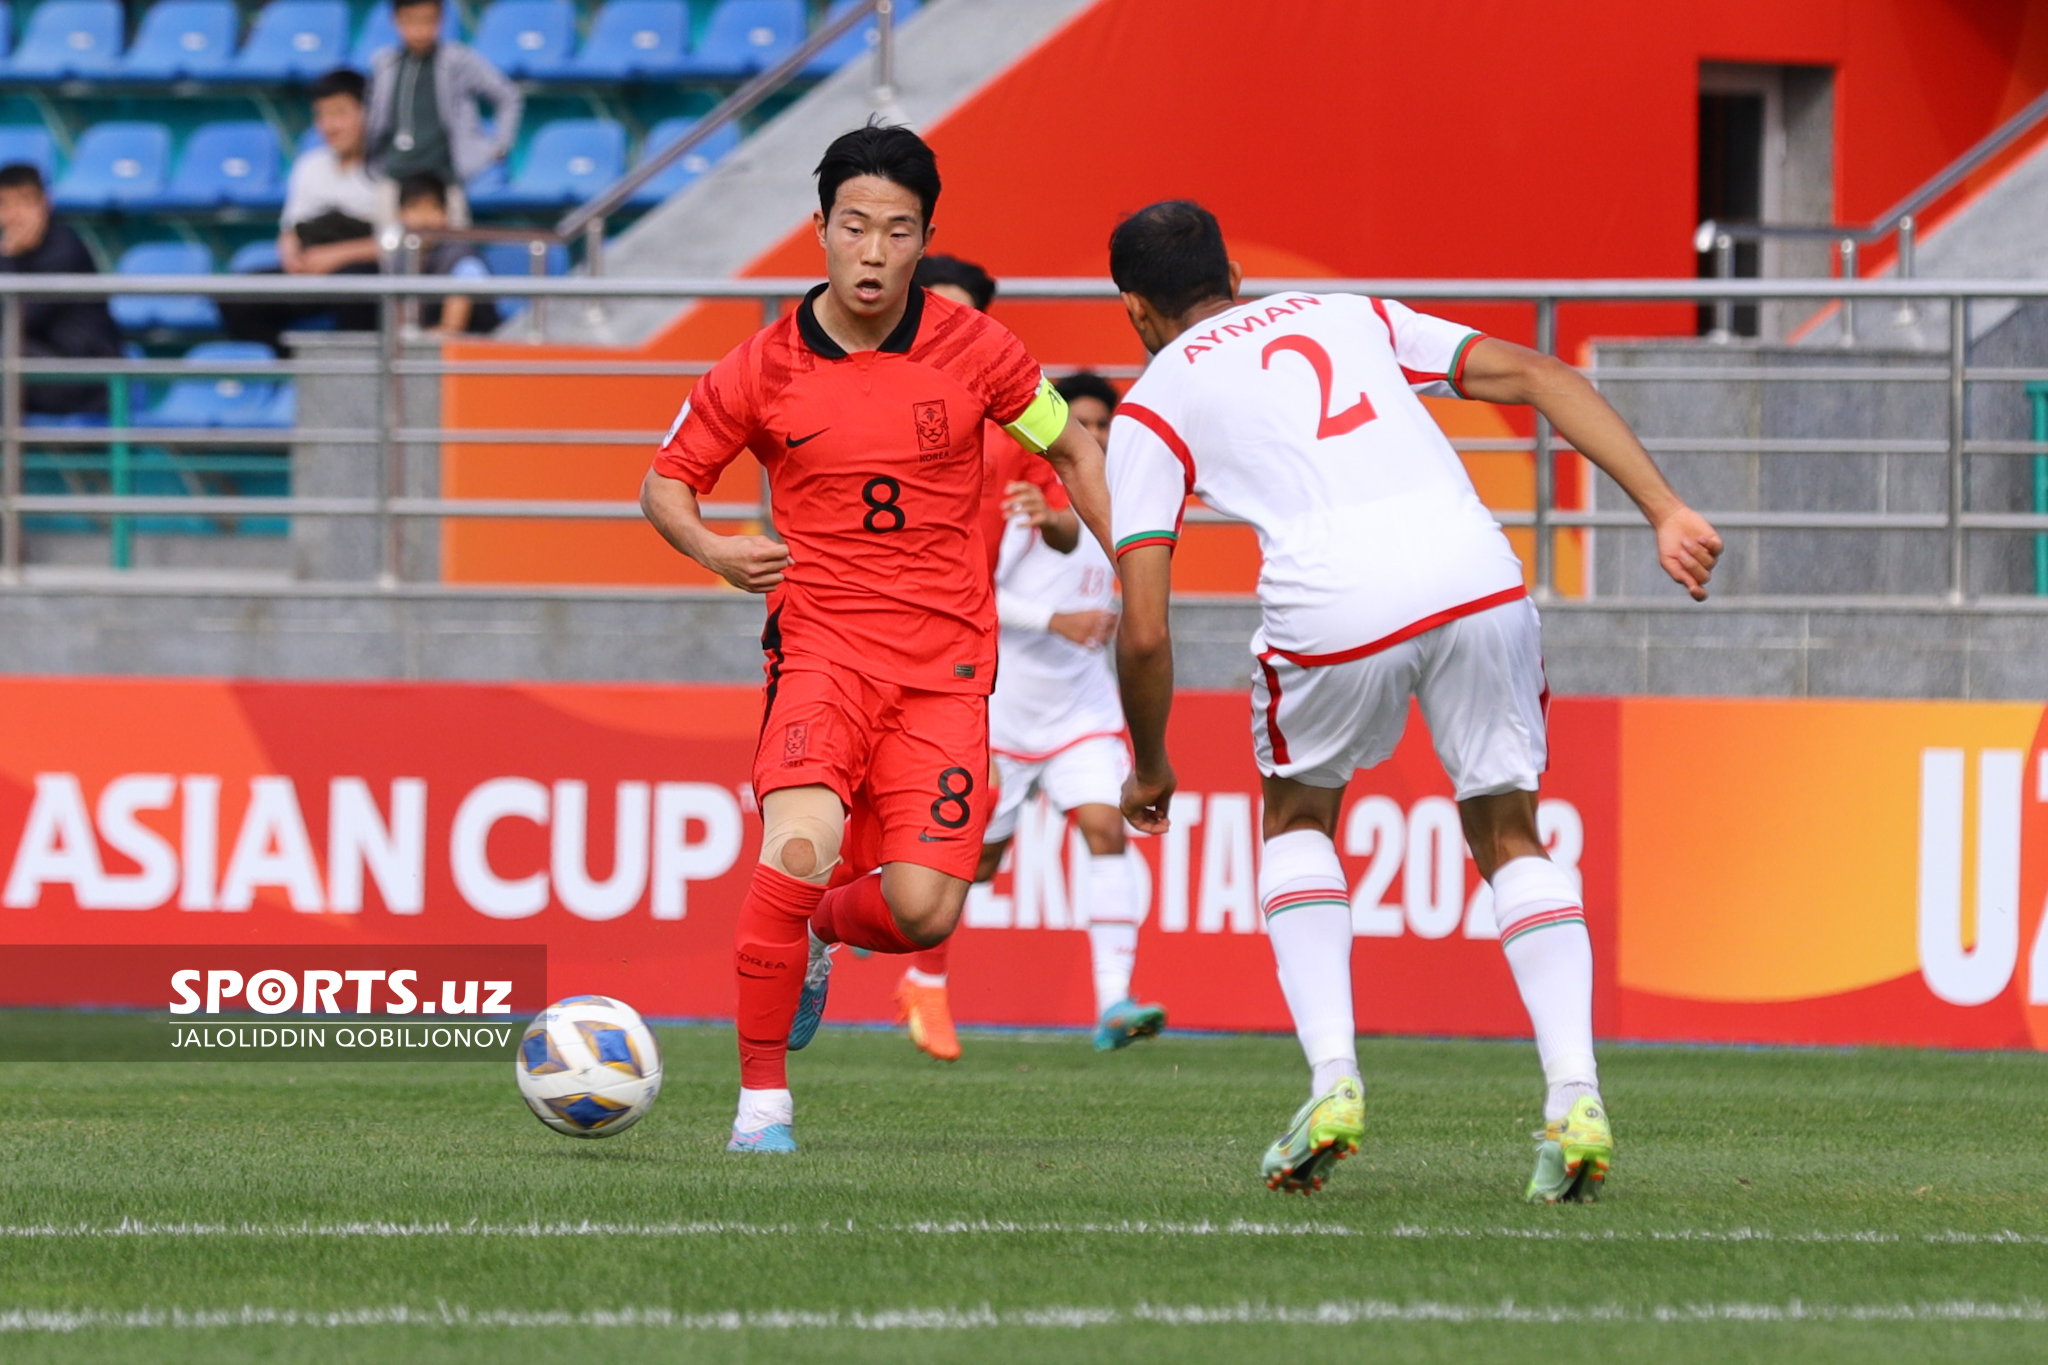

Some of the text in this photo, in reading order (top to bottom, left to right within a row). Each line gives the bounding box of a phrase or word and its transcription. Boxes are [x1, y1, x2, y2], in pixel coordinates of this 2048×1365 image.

[1183, 295, 1321, 364] AYMAN
[1261, 334, 1378, 440] 2
[919, 450, 949, 462] KOREA
[862, 477, 906, 533] 8
[930, 767, 973, 829] 8
[3, 773, 428, 914] ASIAN
[1918, 747, 2048, 1008] U
